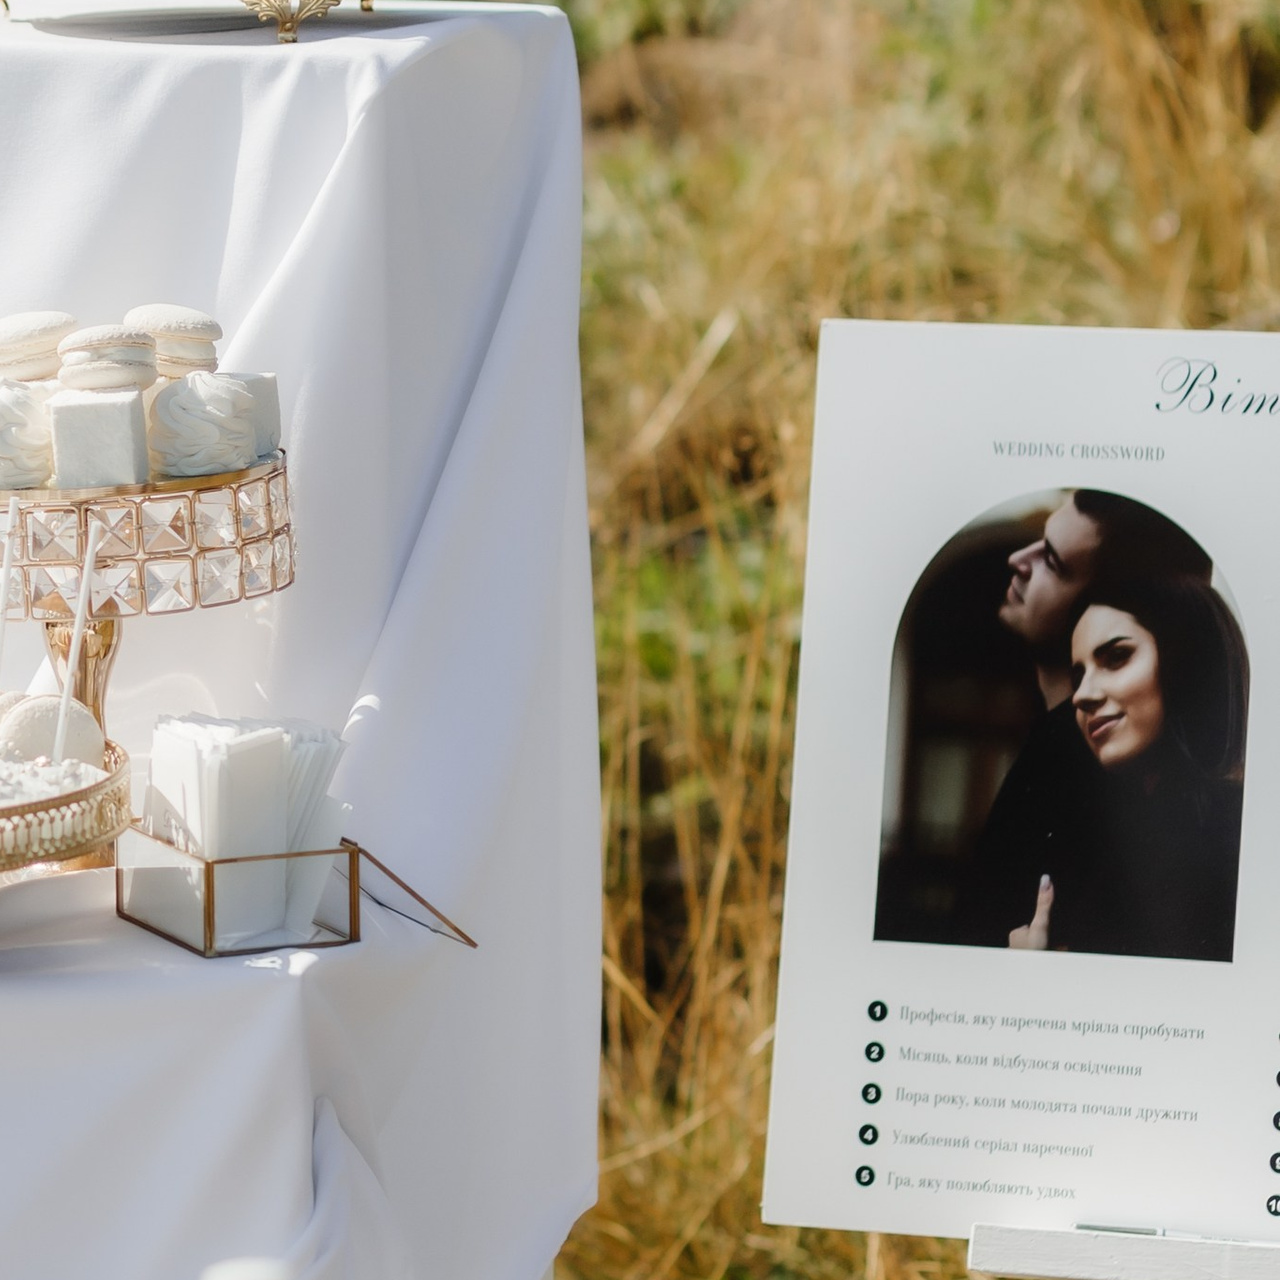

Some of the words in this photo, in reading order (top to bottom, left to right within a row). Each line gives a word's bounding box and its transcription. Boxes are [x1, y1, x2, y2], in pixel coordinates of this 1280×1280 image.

[993, 441, 1065, 458] WEDDING
[1070, 443, 1165, 462] CROSSWORD
[899, 1005, 969, 1027] Професія,
[972, 1014, 998, 1031] яку
[1000, 1015, 1067, 1032] наречена
[1071, 1019, 1119, 1037] мріяла
[1123, 1022, 1206, 1042] спробувати
[898, 1045, 952, 1065] Місяць,
[955, 1053, 988, 1066] коли
[992, 1054, 1060, 1073] відбулося
[1064, 1059, 1143, 1077] освідчення
[895, 1086, 930, 1107] Пора
[933, 1093, 970, 1110] року,
[973, 1095, 1006, 1109] коли
[1010, 1098, 1078, 1114] молодята
[1081, 1103, 1132, 1118] почали
[1135, 1107, 1199, 1123] дружити
[892, 1128, 970, 1149] Улюблений
[974, 1138, 1019, 1155] серіал
[1022, 1141, 1095, 1159] нареченої
[886, 1171, 915, 1190] Гра,
[918, 1178, 943, 1194] яку
[946, 1179, 1034, 1197] полюбляють
[1036, 1185, 1077, 1201] удвох
